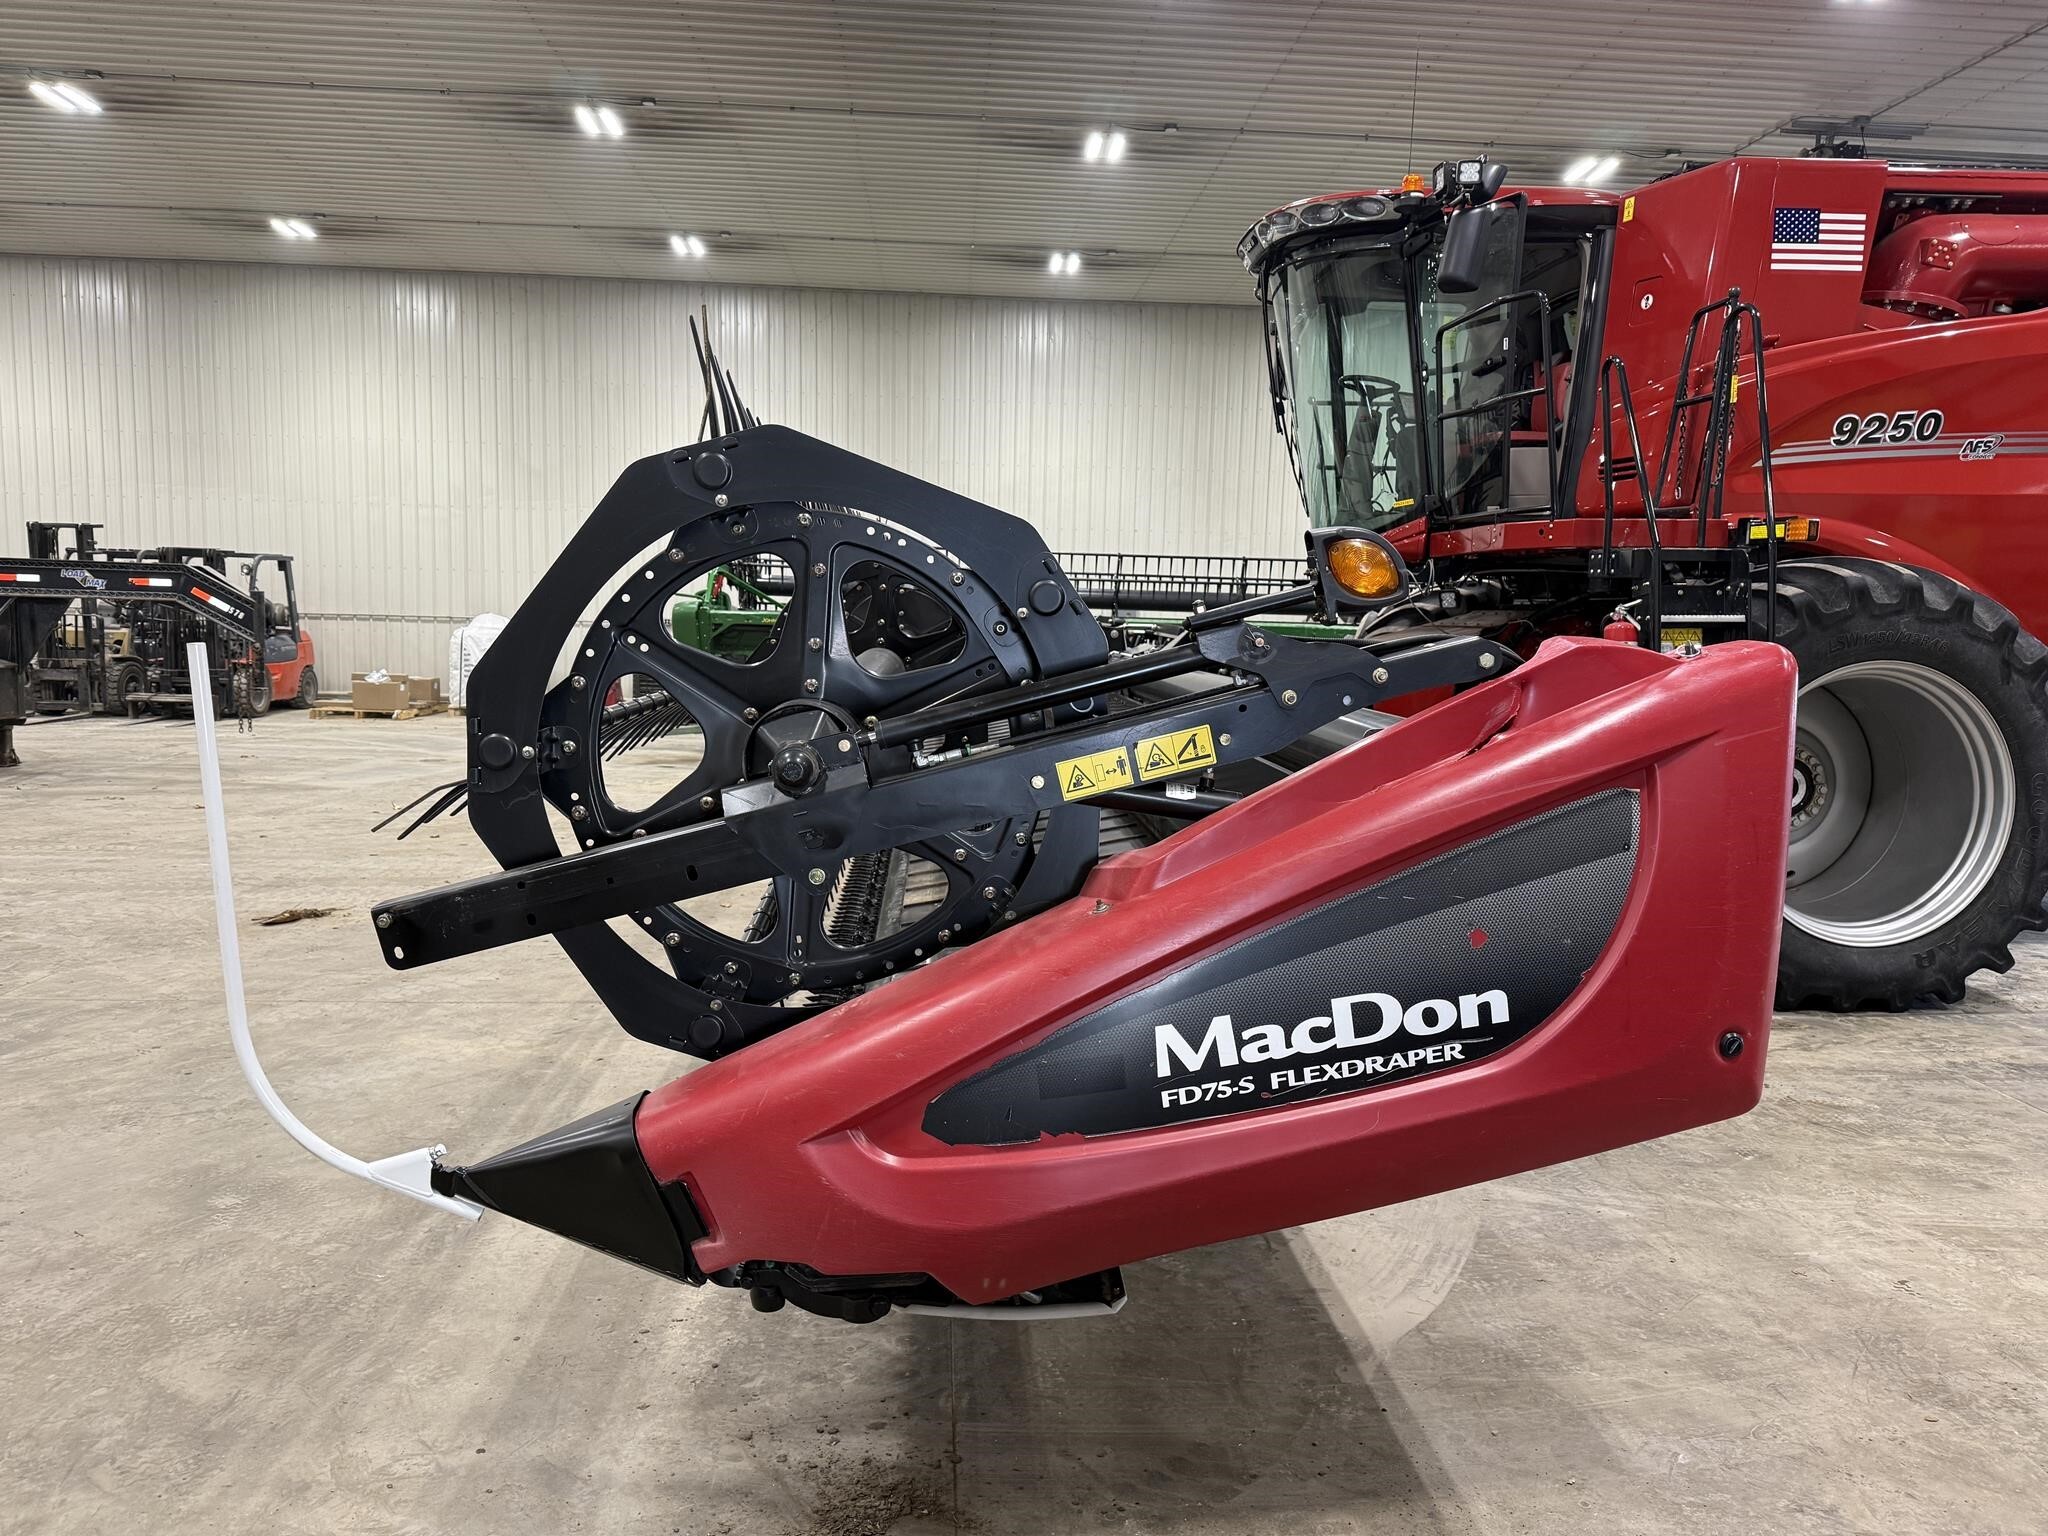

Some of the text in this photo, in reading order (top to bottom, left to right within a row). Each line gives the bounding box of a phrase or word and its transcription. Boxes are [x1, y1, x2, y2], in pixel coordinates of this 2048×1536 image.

[1830, 409, 1944, 448] 9250
[1961, 439, 1994, 453] AFS
[60, 568, 85, 579] LOAD
[86, 577, 108, 590] MAX
[228, 606, 245, 619] 578
[1154, 989, 1510, 1079] MacDon
[1160, 1043, 1466, 1109] FD75-S FLEXDRAPER
